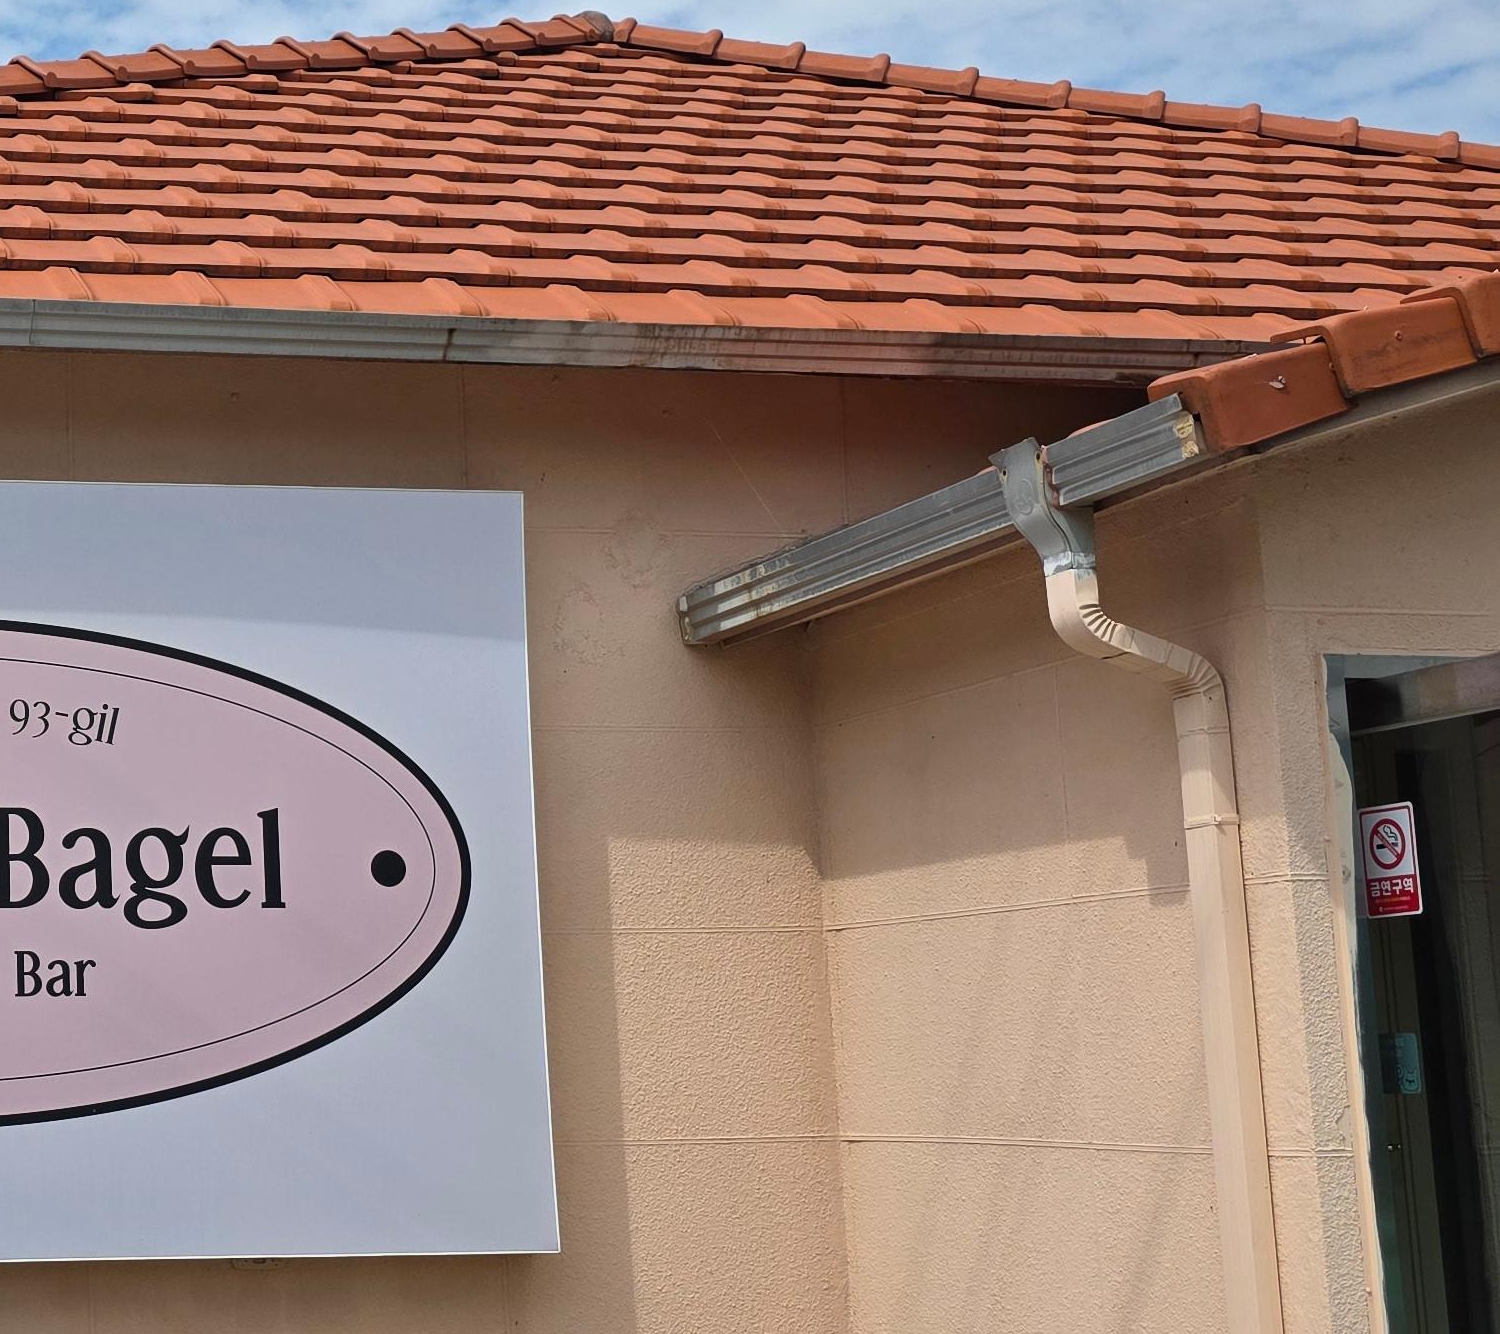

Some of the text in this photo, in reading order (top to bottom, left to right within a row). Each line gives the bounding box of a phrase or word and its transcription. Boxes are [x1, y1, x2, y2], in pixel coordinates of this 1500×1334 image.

[9, 699, 120, 746] 93-gil
[1370, 877, 1414, 897] 금연구역
[14, 950, 98, 998] Bar
